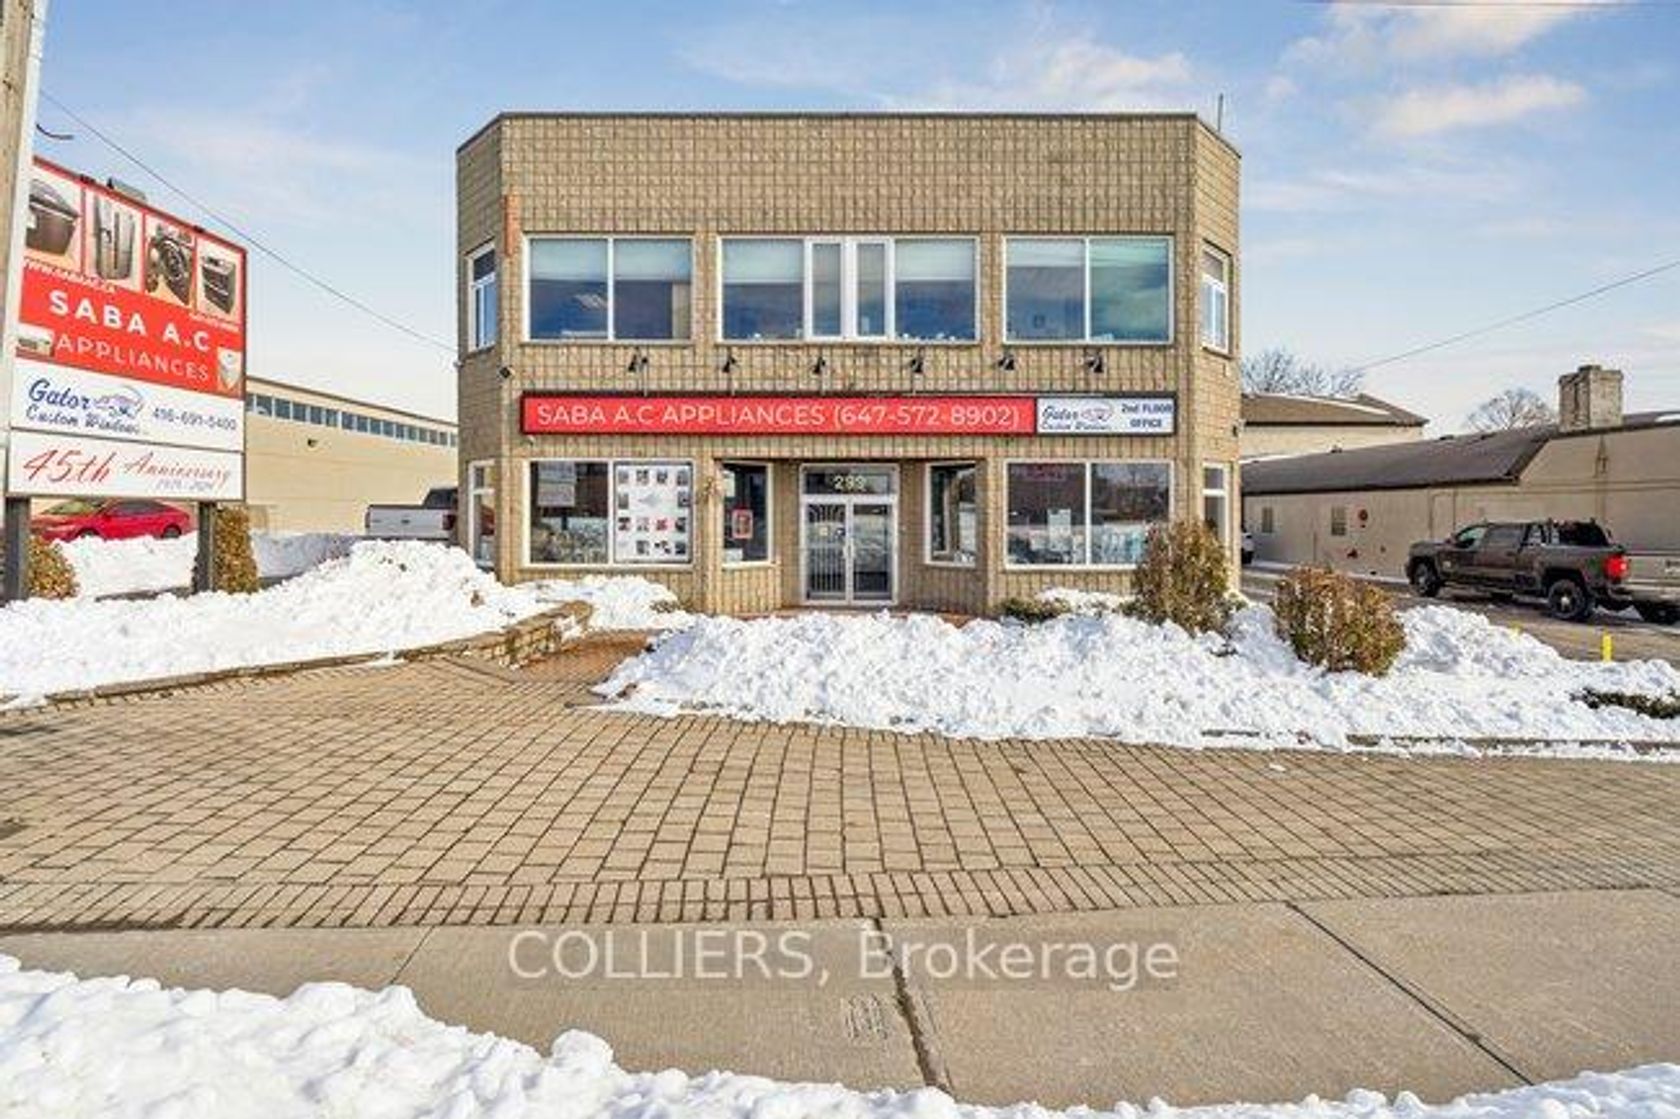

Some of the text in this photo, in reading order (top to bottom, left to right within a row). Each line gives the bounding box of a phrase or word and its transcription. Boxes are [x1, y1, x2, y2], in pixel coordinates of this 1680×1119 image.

[48, 290, 147, 337] SABA
[162, 322, 210, 351] A.C
[56, 333, 209, 381] APPLIANCES
[28, 378, 89, 410] Gator
[26, 404, 78, 427] Custom
[537, 404, 1020, 428] SABA A.C APPLIANCES (647-572-8902)
[23, 449, 117, 482] 45th
